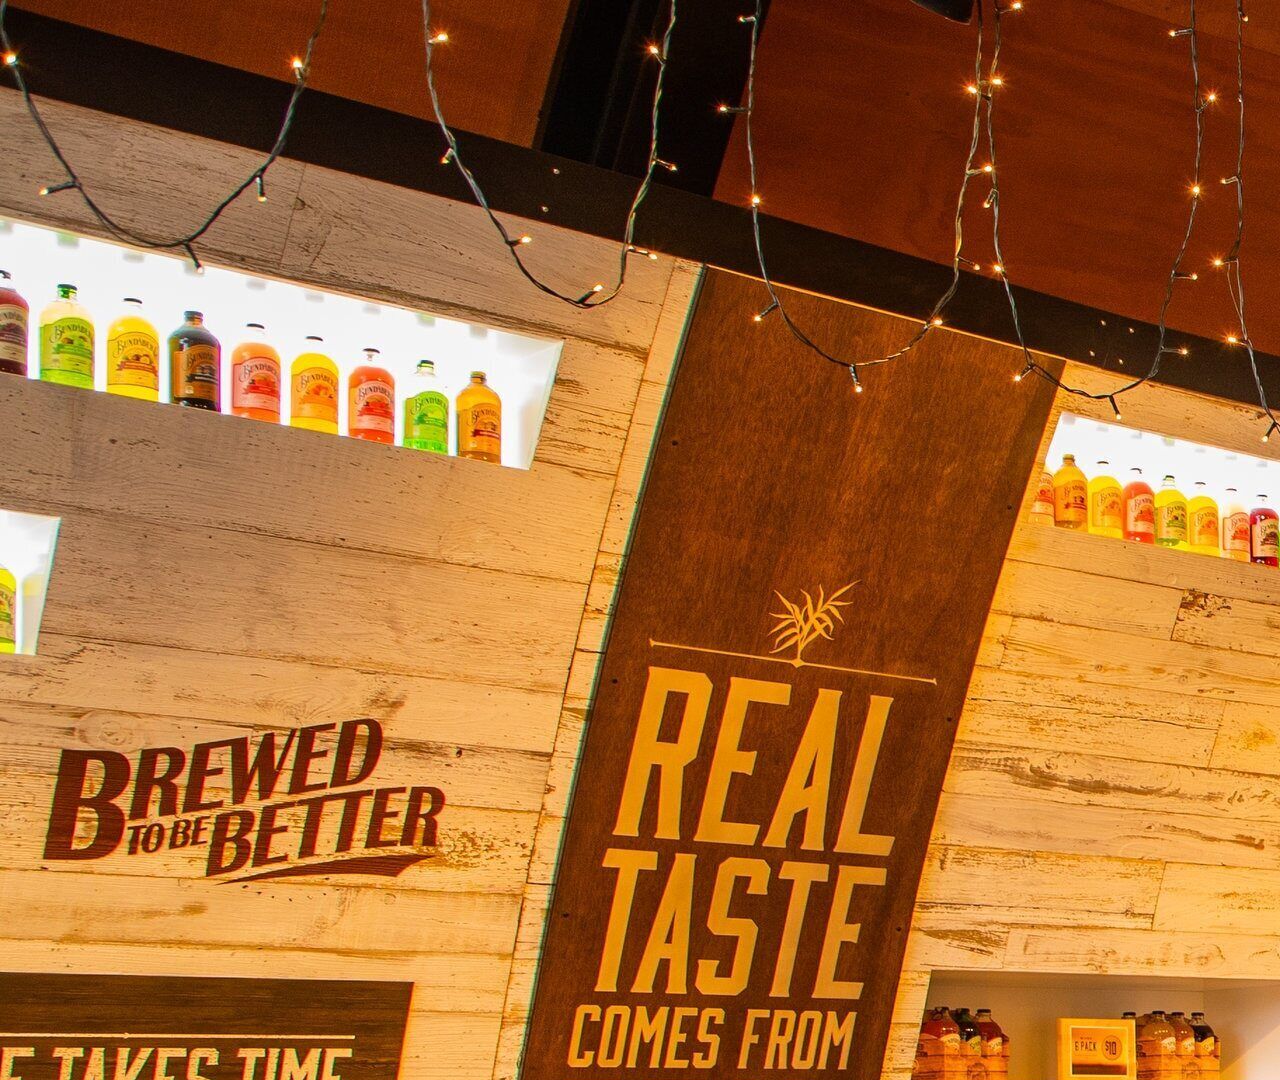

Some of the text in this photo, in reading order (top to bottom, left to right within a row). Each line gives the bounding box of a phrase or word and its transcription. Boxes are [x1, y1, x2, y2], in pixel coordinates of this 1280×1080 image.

[43, 718, 383, 860] BREWED
[612, 666, 895, 856] REAL
[127, 819, 208, 856] TO BE
[205, 786, 446, 878] BETTER
[594, 848, 887, 1000] TASTE
[567, 1004, 858, 1070] COMES FROM
[1075, 1041, 1097, 1051] 6 PACK
[1105, 1040, 1117, 1055] $10
